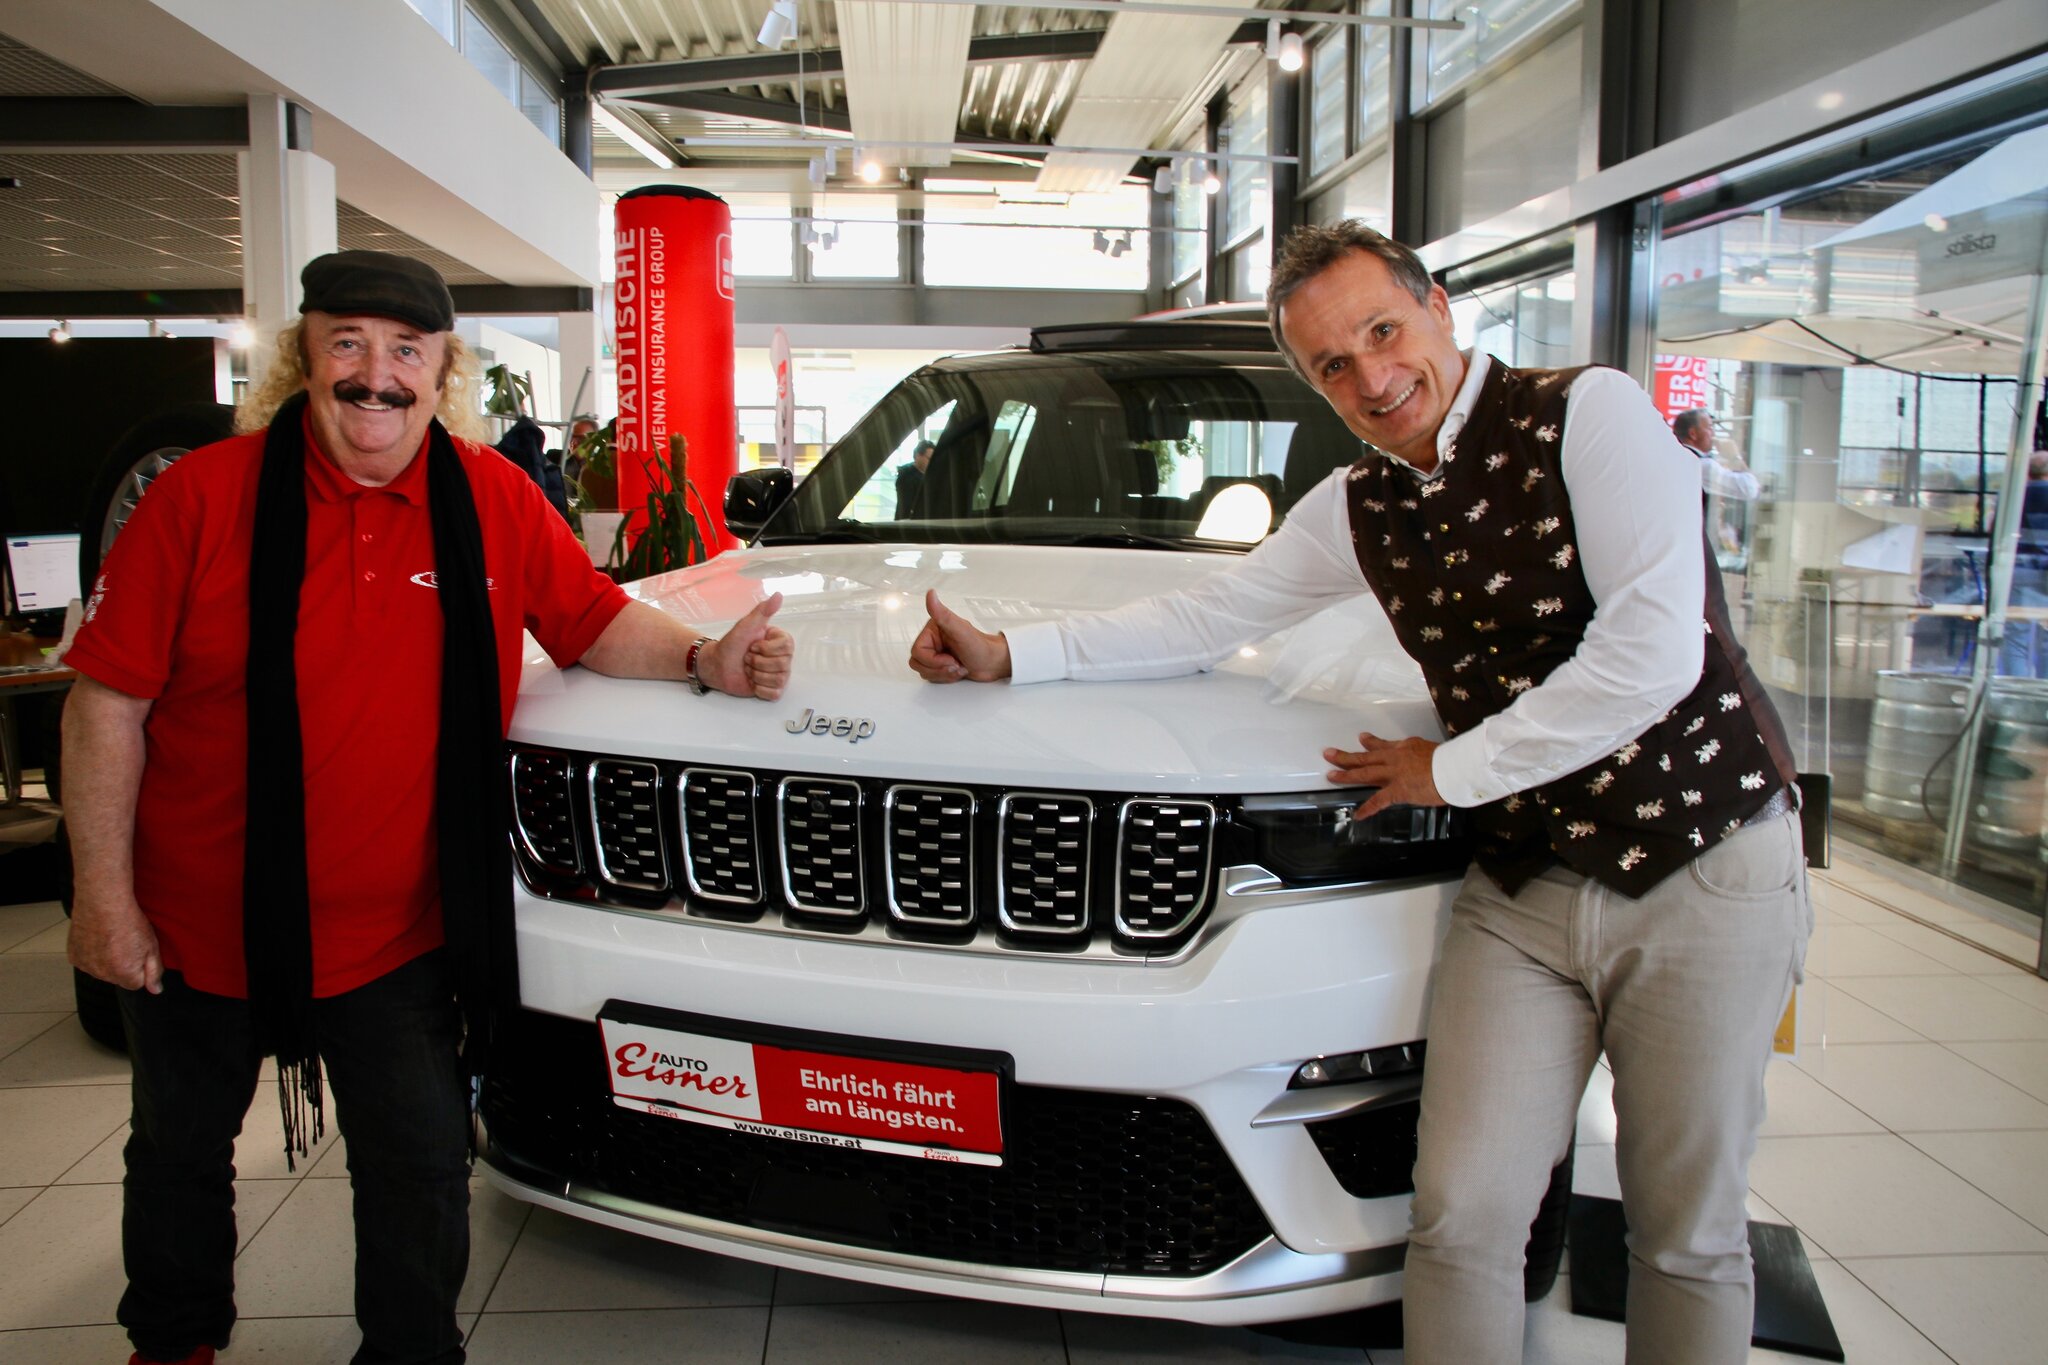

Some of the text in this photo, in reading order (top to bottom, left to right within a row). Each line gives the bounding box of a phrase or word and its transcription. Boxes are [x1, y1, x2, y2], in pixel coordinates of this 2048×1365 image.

[650, 226, 667, 450] VIENNA INSURANCE GROUP
[785, 708, 876, 744] Jeep
[614, 1042, 751, 1099] Eisner
[659, 1053, 708, 1072] AUTO
[799, 1068, 956, 1109] Ehrlich fährt
[805, 1097, 965, 1133] am längsten.
[733, 1121, 863, 1150] www.eisner.at
